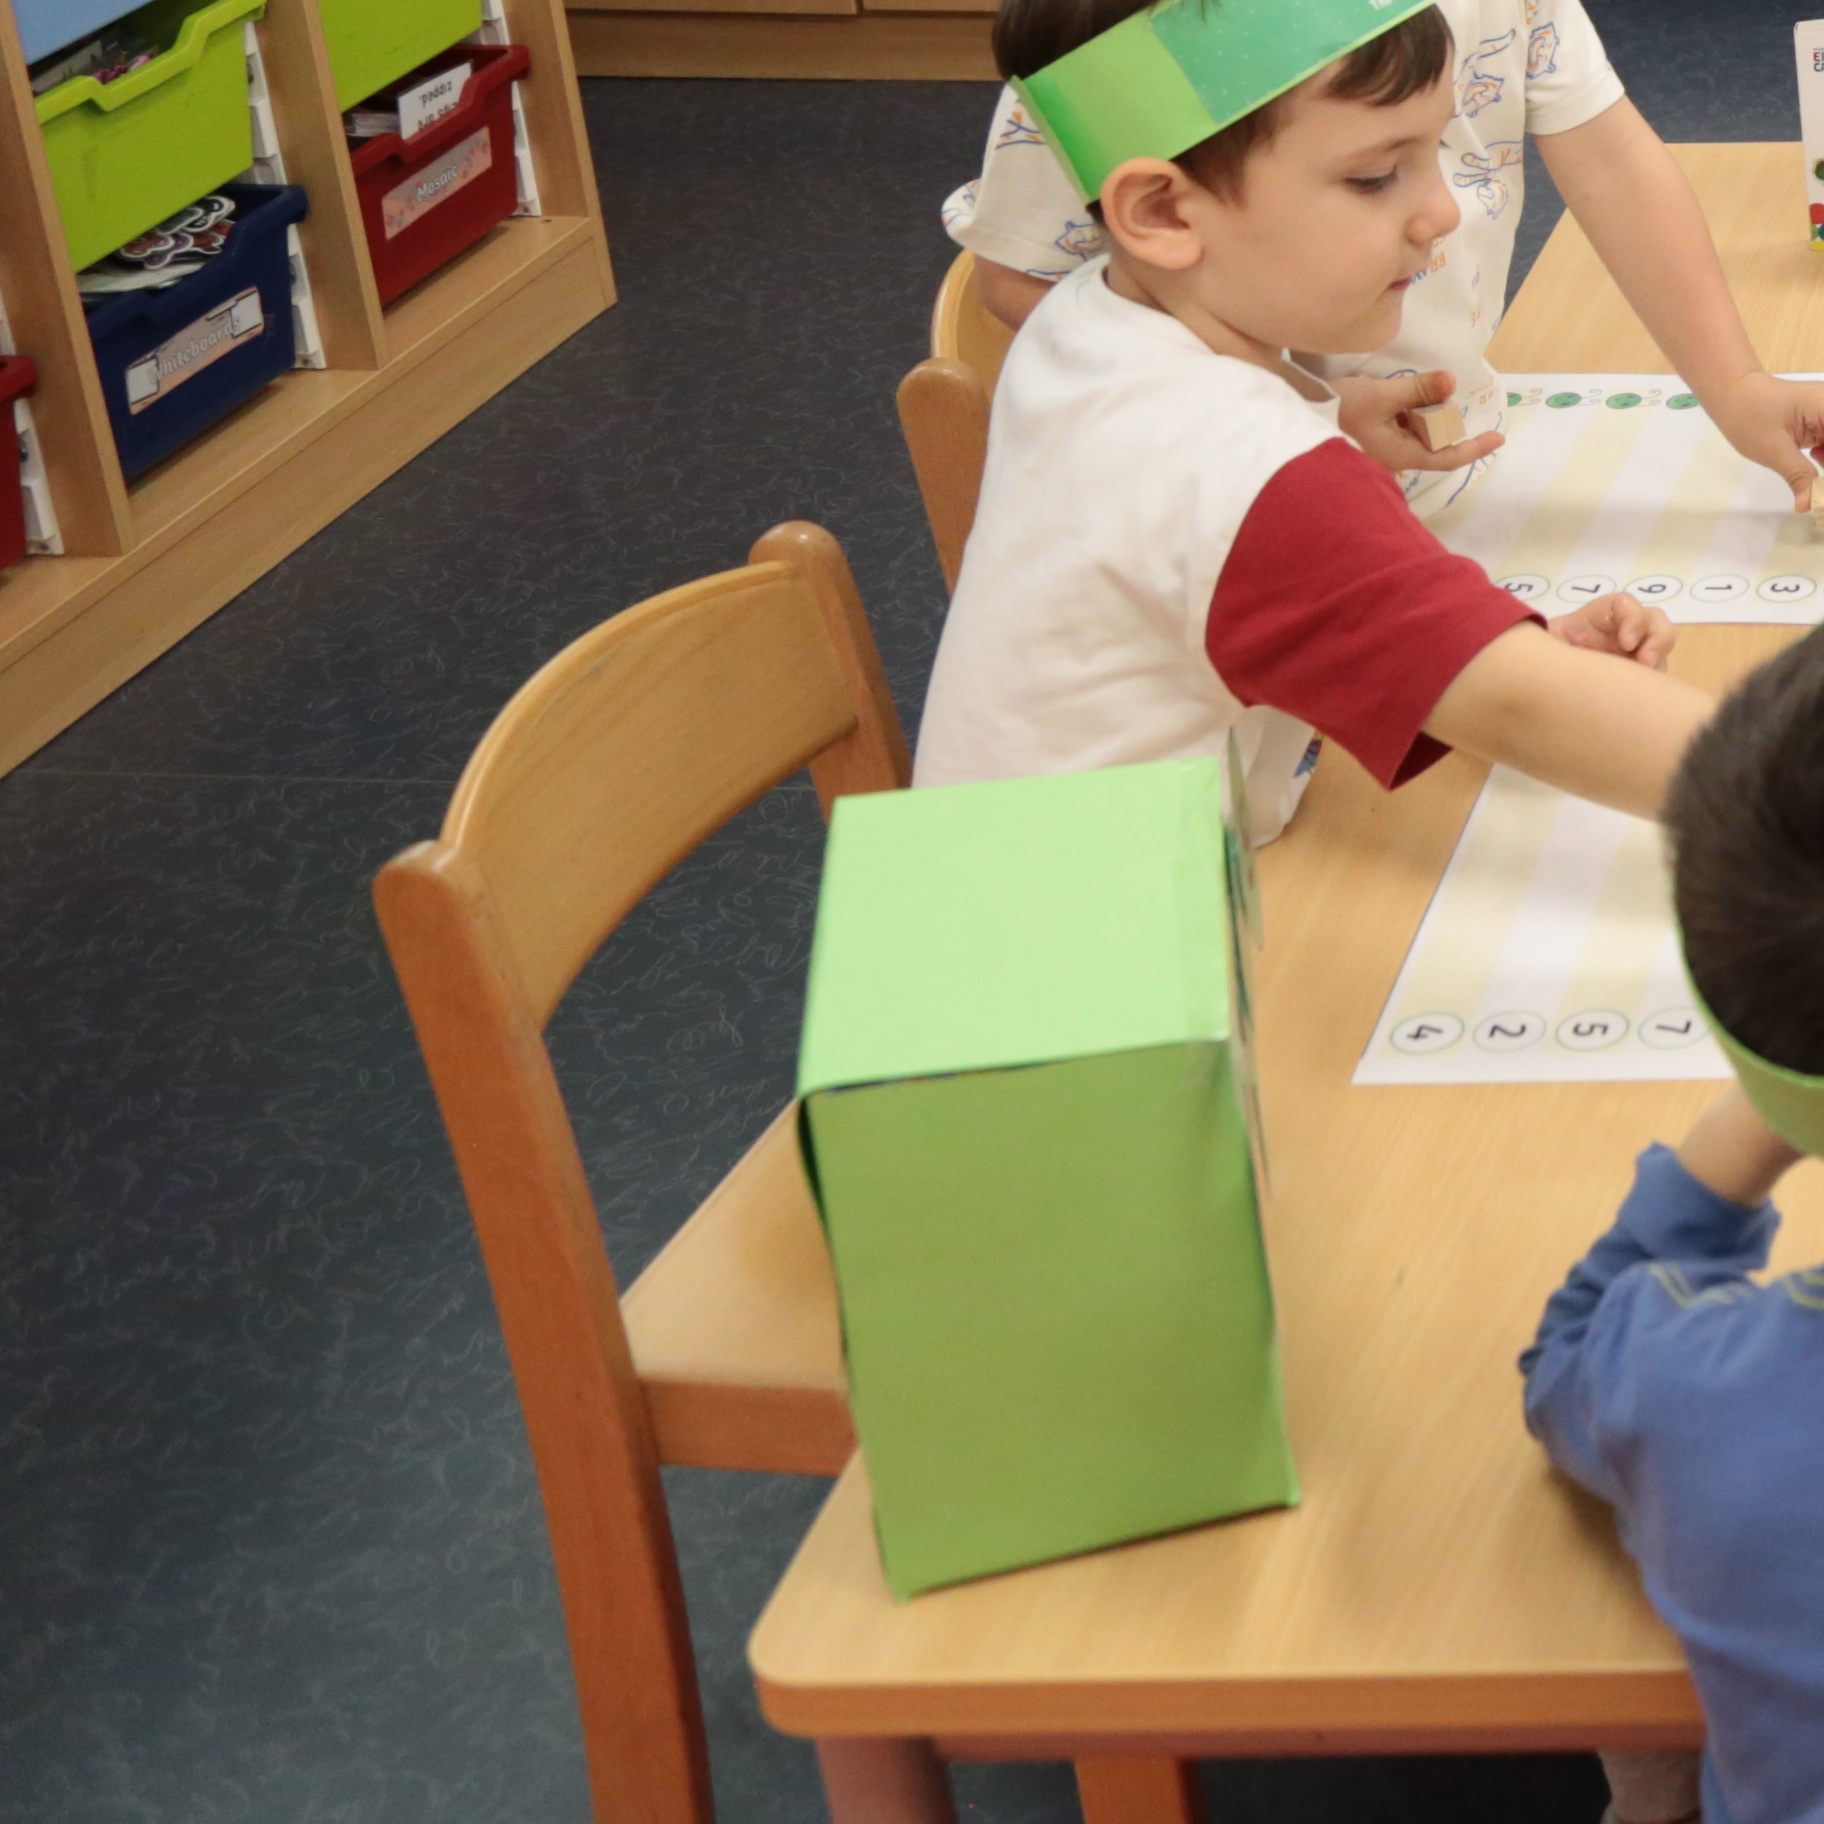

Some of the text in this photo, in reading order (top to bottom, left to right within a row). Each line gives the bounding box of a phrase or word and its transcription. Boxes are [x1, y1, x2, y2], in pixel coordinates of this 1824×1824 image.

[416, 164, 458, 201] Mosaic
[148, 316, 242, 386] Whiteboards
[1407, 1025, 1445, 1042] 4
[1488, 1024, 1527, 1038] 2
[1573, 1023, 1609, 1037] 5
[1655, 1020, 1691, 1036] 7
